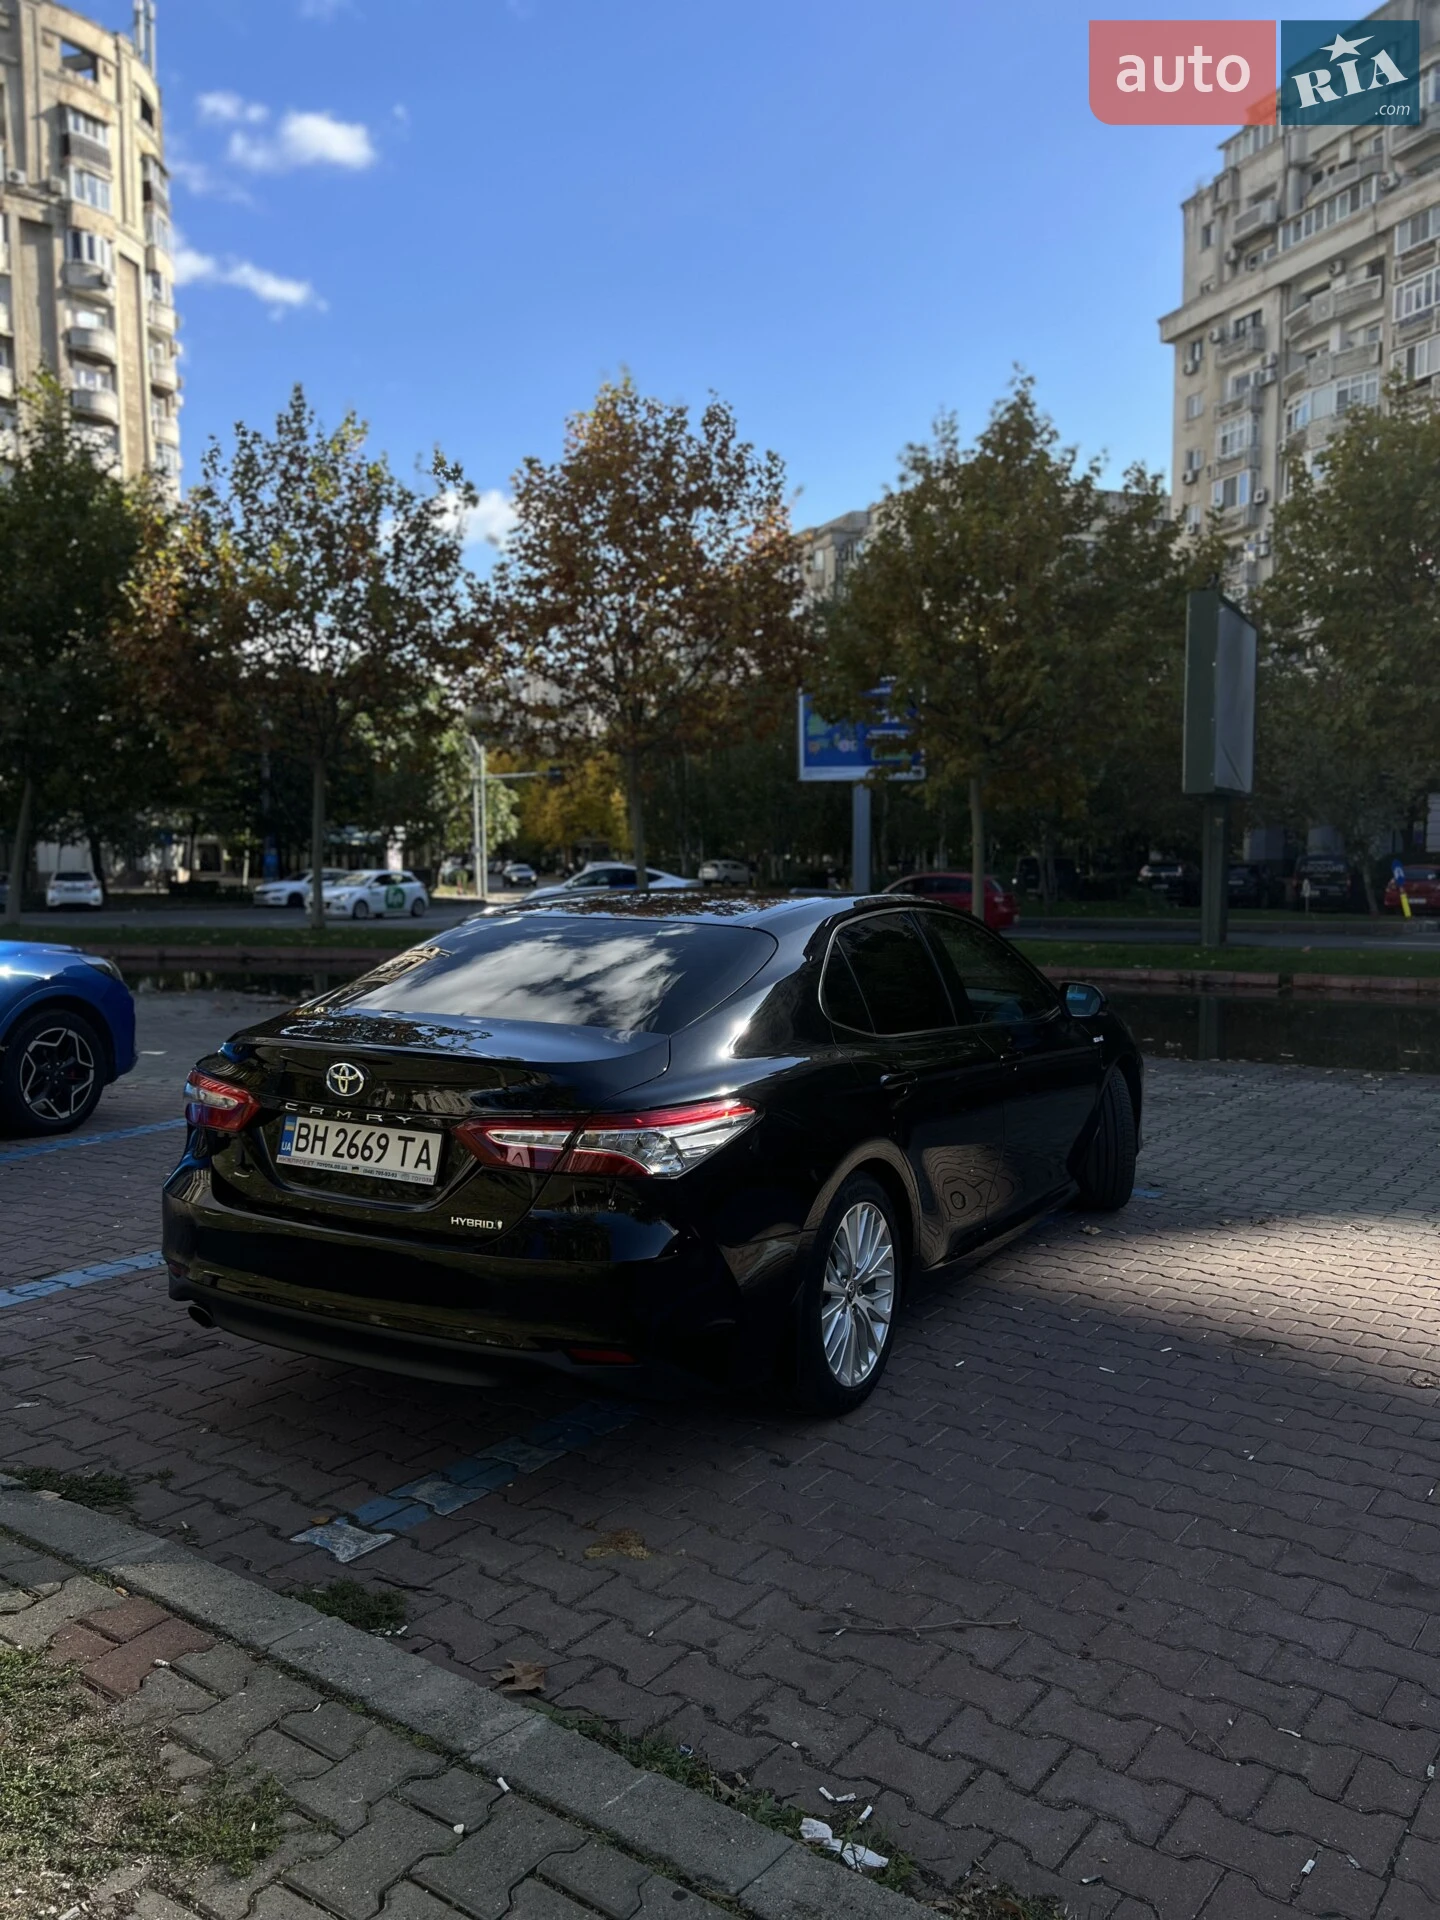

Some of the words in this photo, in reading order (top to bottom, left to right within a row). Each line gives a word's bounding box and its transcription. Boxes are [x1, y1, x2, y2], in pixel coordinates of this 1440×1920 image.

[284, 1101, 413, 1125] CAMRY
[281, 1141, 291, 1152] UA
[295, 1122, 329, 1156] BH
[332, 1127, 390, 1163] 2669
[398, 1135, 431, 1171] TA
[411, 1175, 433, 1184] TOYOTA
[450, 1216, 495, 1230] HYBRID
